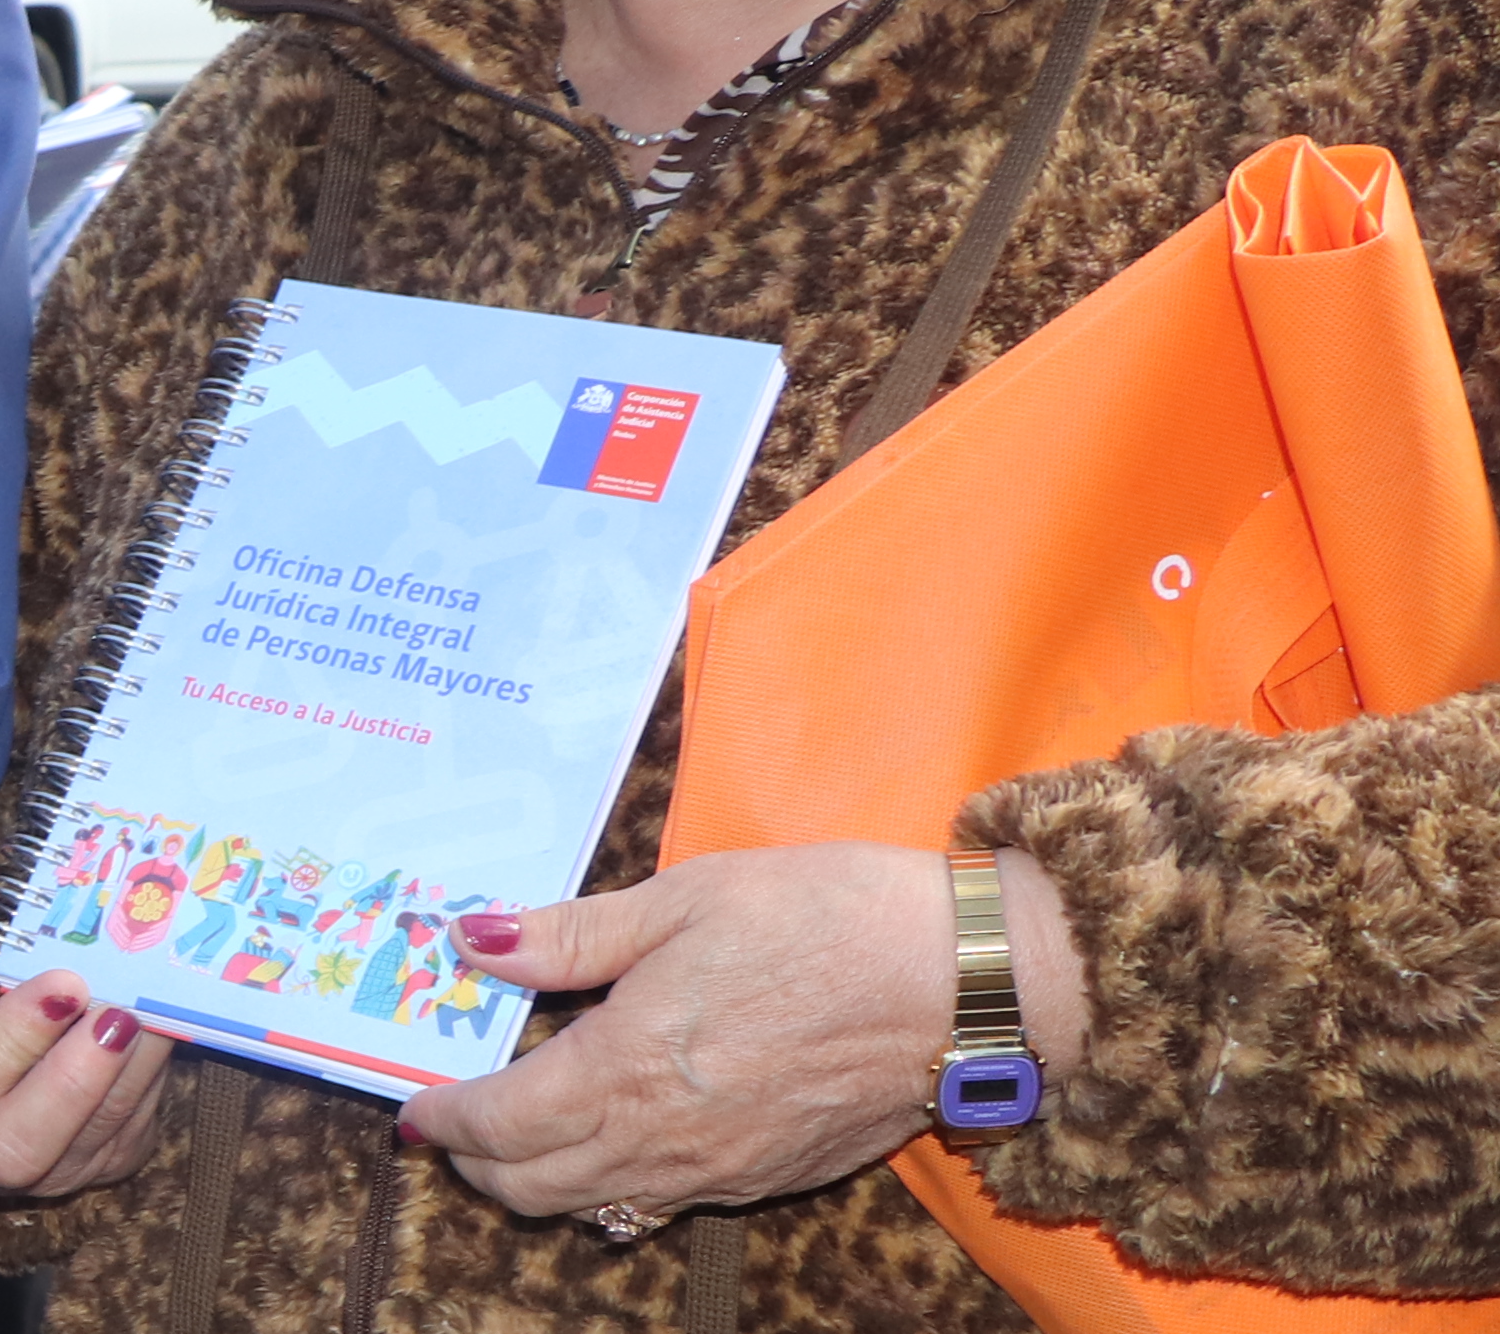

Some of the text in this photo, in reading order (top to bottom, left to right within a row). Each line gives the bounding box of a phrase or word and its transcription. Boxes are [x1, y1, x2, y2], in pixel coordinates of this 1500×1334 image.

[617, 415, 656, 429] Judicial
[622, 404, 686, 421] de Asistencia
[627, 391, 686, 408] Corporación
[233, 545, 481, 614] Oficina Defensa
[215, 581, 476, 653] Jurídica Integral
[201, 618, 534, 705] de Personas Mayores
[181, 676, 433, 746] Tu Acceso a la Justicia
